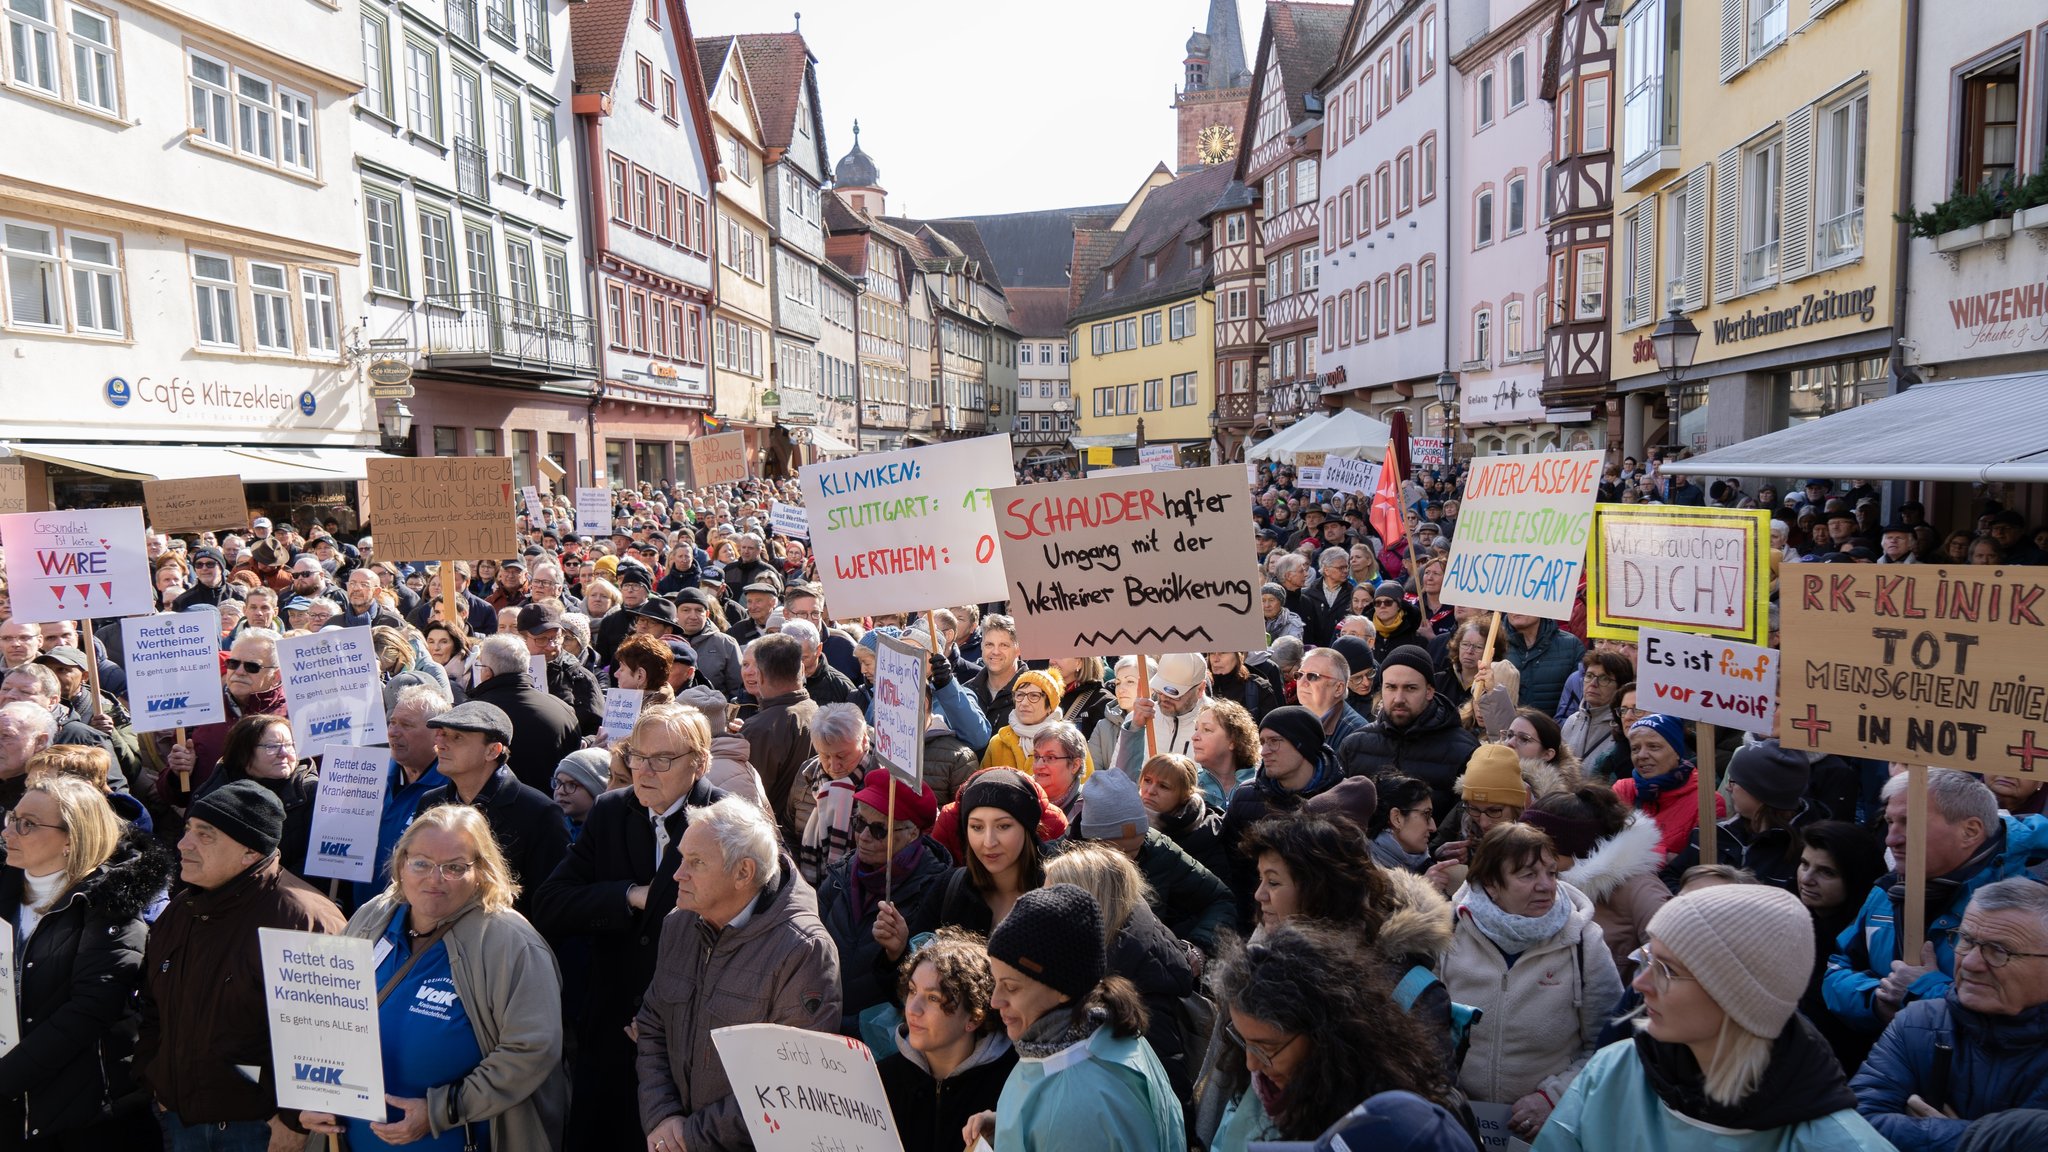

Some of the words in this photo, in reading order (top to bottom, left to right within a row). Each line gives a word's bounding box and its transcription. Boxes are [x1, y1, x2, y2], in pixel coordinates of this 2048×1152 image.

[1949, 276, 2048, 330] WINZENH
[1713, 305, 1801, 345] Wertheimer
[1801, 285, 1876, 326] Zeitung
[1964, 319, 2014, 349] Schuhe
[137, 377, 195, 413] Café
[202, 381, 294, 410] Klitzeklein
[1468, 395, 1488, 404] Gelato
[368, 459, 407, 484] Seid
[411, 459, 426, 482] Ihr
[432, 460, 467, 492] völlig
[1326, 467, 1373, 490] SCHAUDERT!
[1339, 459, 1373, 475] MICH
[819, 460, 921, 498] KLINIKEN:
[1466, 458, 1599, 500] UNTERLASSENE
[166, 500, 196, 509] ANGST
[379, 486, 402, 510] Die
[411, 483, 457, 509] Klinik
[466, 483, 511, 509] bleibt!
[373, 513, 391, 526] Den
[447, 511, 463, 522] der
[464, 510, 511, 525] Schließung
[827, 495, 939, 531] STUTTGART:
[962, 488, 992, 512] 17
[34, 518, 89, 534] Gesundheit
[1457, 508, 1590, 546] HILFELEISTUNG
[55, 535, 66, 546] ist
[73, 538, 94, 546] keine
[373, 530, 423, 559] FAHRT
[422, 528, 462, 556] ZUR
[469, 527, 513, 555] HÖLLE
[1043, 542, 1121, 571] Umgang
[1132, 528, 1160, 554] mit
[1173, 531, 1213, 552] der
[1608, 525, 1644, 556] Wir
[1650, 528, 1740, 562] brauchen
[37, 551, 107, 576] WARE
[834, 544, 951, 580] WERTHEIM:
[975, 534, 995, 564] 0
[1017, 580, 1115, 616] Wertheimer
[1123, 572, 1252, 615] Bevölkerung
[1624, 560, 1738, 617] DICH!
[140, 625, 175, 637] Rettet
[179, 624, 199, 634] das
[132, 645, 212, 662] Krankenhaus!
[136, 636, 204, 649] Wertheimer
[295, 645, 332, 658] Rettet
[335, 641, 357, 651] das
[1872, 627, 1979, 675] TOT
[292, 653, 363, 672] Wertheimer
[1647, 637, 1675, 667] Es
[1683, 650, 1713, 672] ist
[1719, 648, 1770, 682] fünf
[147, 668, 163, 677] geht
[290, 662, 371, 685] Krankenhaus!
[306, 690, 323, 699] geht
[340, 682, 358, 691] ALLE
[1805, 660, 1979, 709] MENSCHEN
[147, 696, 189, 712] VdK
[622, 700, 633, 708] das
[1654, 682, 1696, 703] vor
[1700, 690, 1768, 719] zwölf
[310, 717, 352, 735] VdK
[1906, 717, 1987, 761] NOT
[333, 758, 359, 770] Rettet
[361, 760, 376, 771] das
[328, 771, 378, 786] Wertheimer
[322, 784, 379, 800] Krankenhaus!
[328, 806, 340, 814] geht
[320, 841, 351, 856] VdK
[282, 949, 325, 968] Rettet
[330, 955, 355, 971] das
[279, 967, 361, 991] Wertheimer
[274, 985, 369, 1011] Krankenhaus!
[415, 985, 459, 1007] VdK
[280, 1013, 291, 1023] Es
[293, 1015, 313, 1026] geht
[314, 1019, 331, 1028] uns
[332, 1020, 353, 1032] ALLE
[355, 1023, 369, 1034] an!
[776, 1041, 813, 1065] stirbt
[820, 1048, 847, 1074] das
[294, 1063, 344, 1085] VdK
[754, 1085, 887, 1132] KRANKENHAUS
